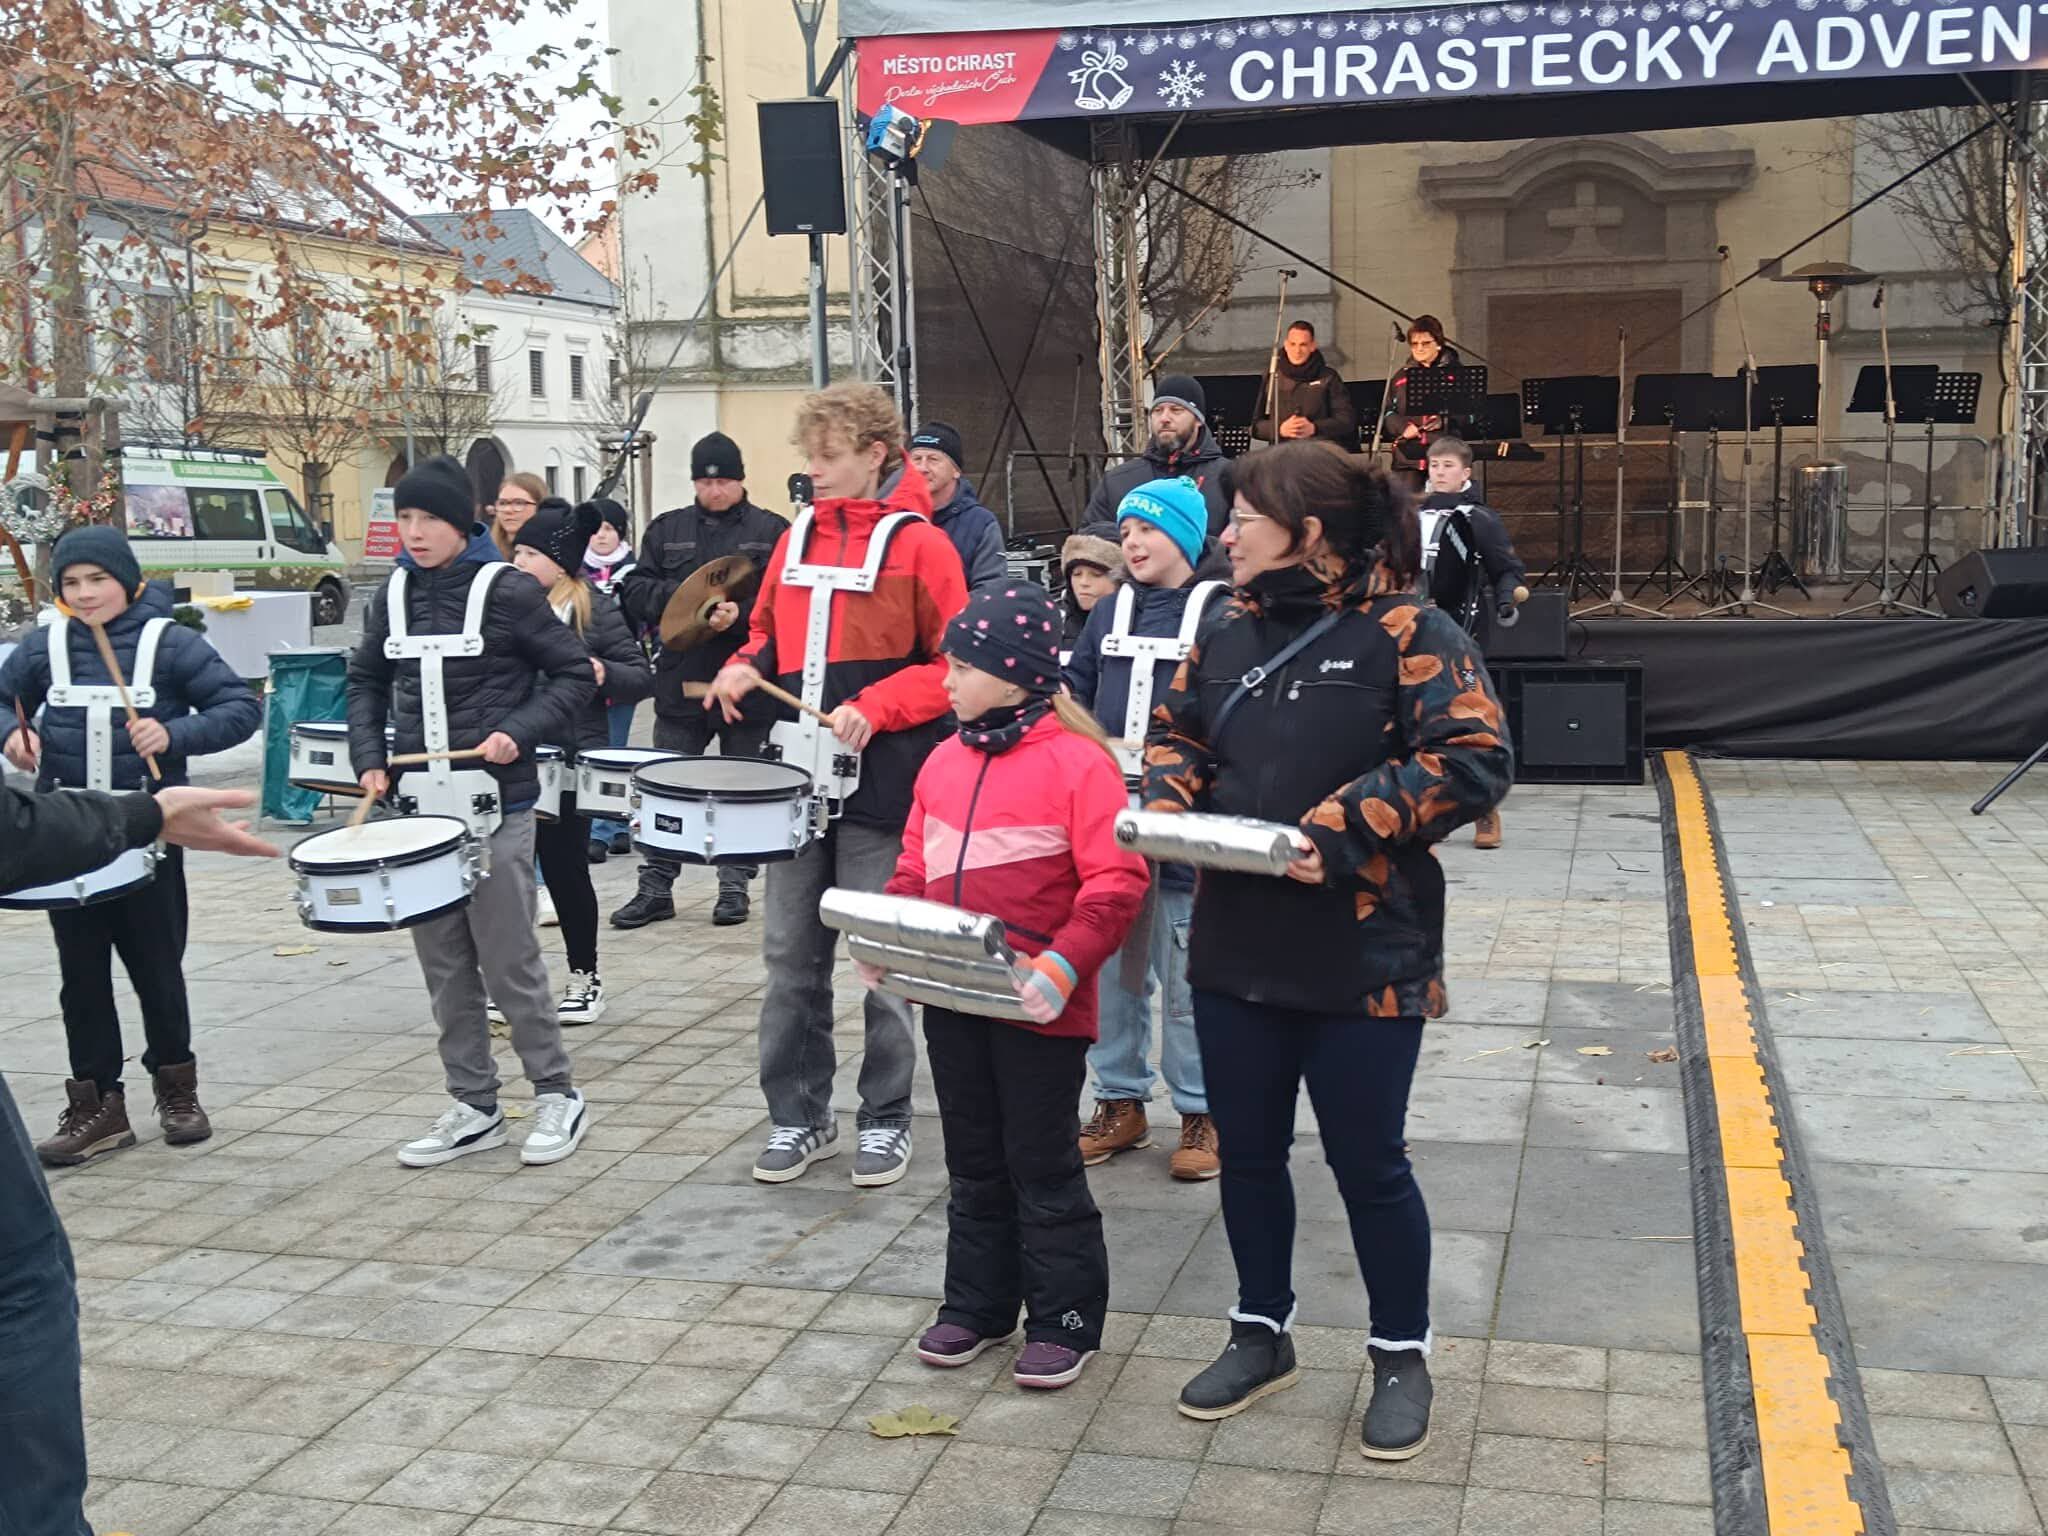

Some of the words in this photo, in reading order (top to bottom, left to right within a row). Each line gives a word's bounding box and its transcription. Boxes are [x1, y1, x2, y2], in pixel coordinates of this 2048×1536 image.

[882, 54, 943, 75] MĚSTO
[945, 52, 1017, 72] CHRAST
[1229, 11, 1735, 102] CHRASTECKÝ
[1756, 3, 2048, 76] ADVEN
